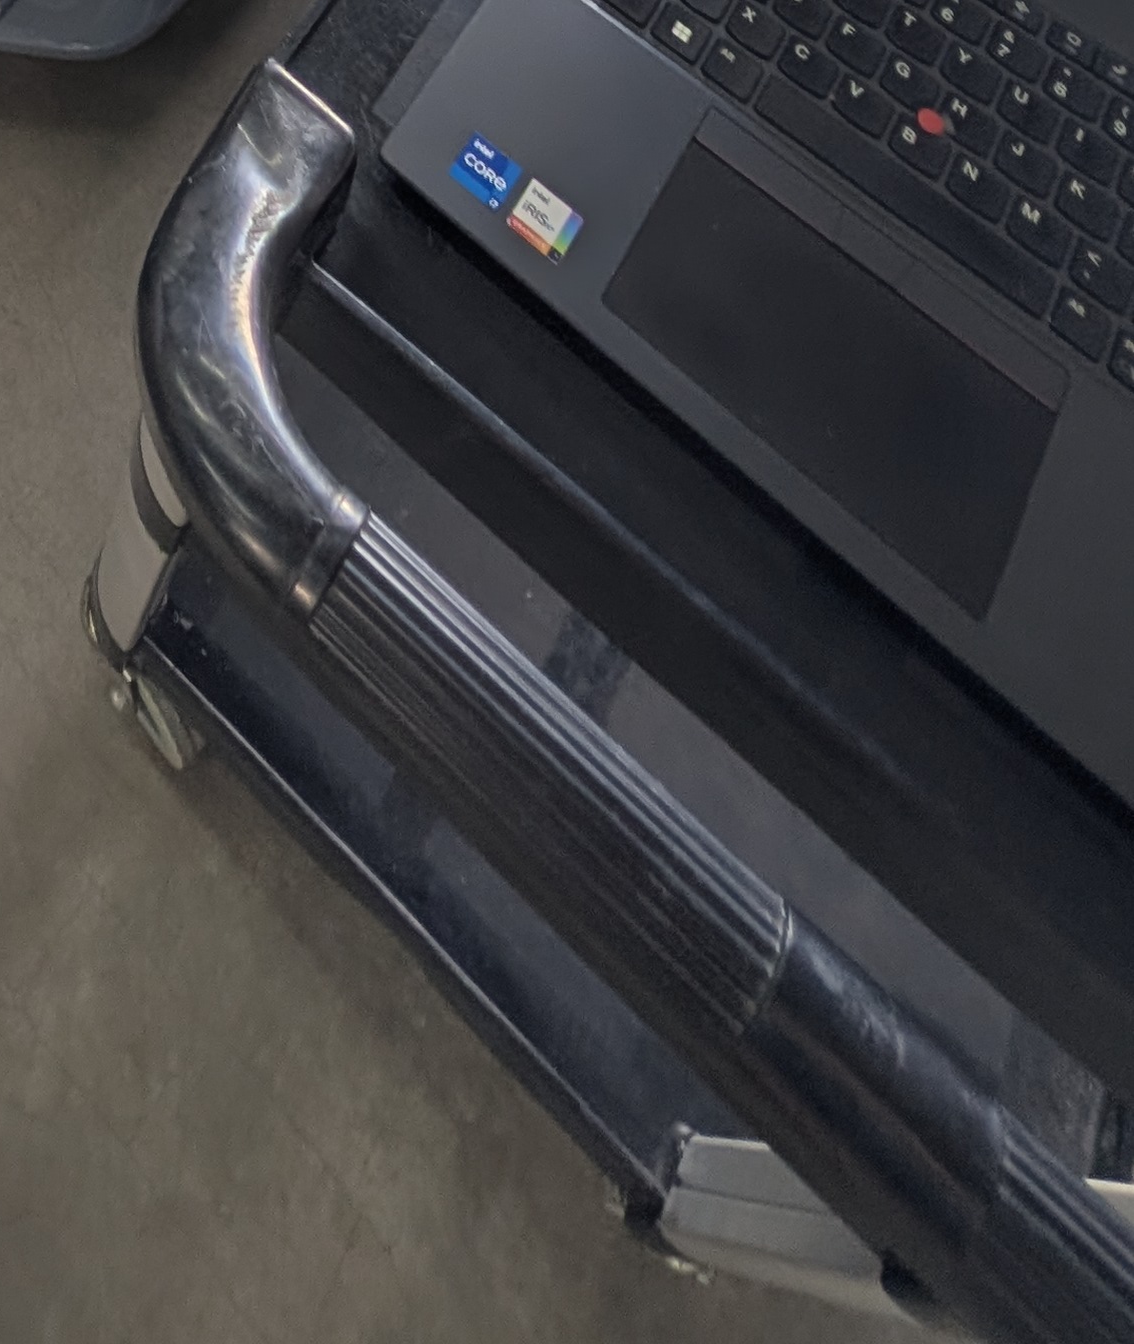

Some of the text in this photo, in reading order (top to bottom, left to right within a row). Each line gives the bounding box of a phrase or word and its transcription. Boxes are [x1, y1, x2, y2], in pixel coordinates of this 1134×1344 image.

[741, 6, 757, 23] X
[904, 11, 917, 27] T
[940, 7, 955, 22] 6
[842, 22, 856, 36] F
[794, 43, 810, 60] C
[959, 47, 972, 64] Y
[895, 61, 911, 79] G
[850, 80, 865, 98] V
[1013, 85, 1030, 104] U
[951, 98, 968, 118] H
[901, 125, 917, 145] B
[963, 160, 979, 182] N
[1070, 179, 1086, 199] K
[1021, 201, 1041, 224] M
